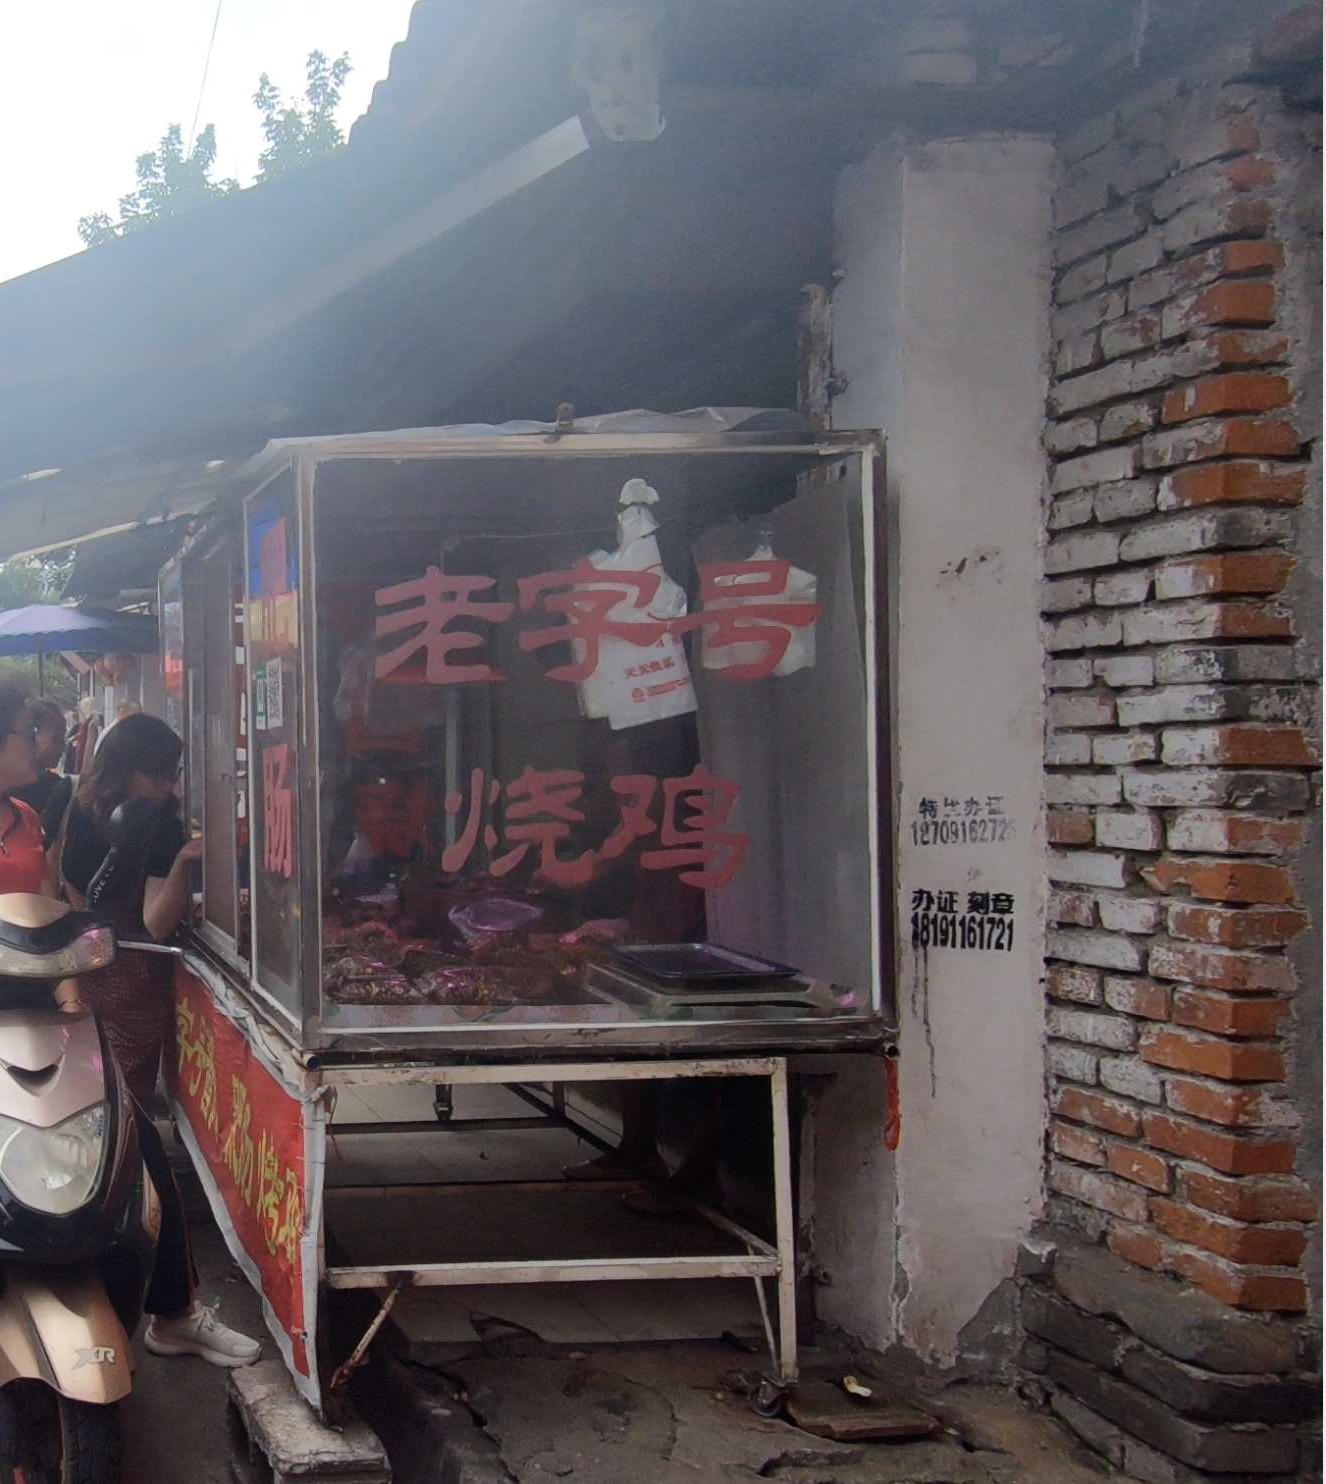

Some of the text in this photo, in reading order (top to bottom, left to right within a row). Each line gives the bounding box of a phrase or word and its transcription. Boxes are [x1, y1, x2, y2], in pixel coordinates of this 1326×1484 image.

[374, 556, 822, 684] 老字号
[442, 764, 750, 889] 烧鸡
[912, 888, 1015, 915] 办证 刻章
[911, 911, 1014, 952] 18191161721
[71, 1345, 116, 1371] XR
